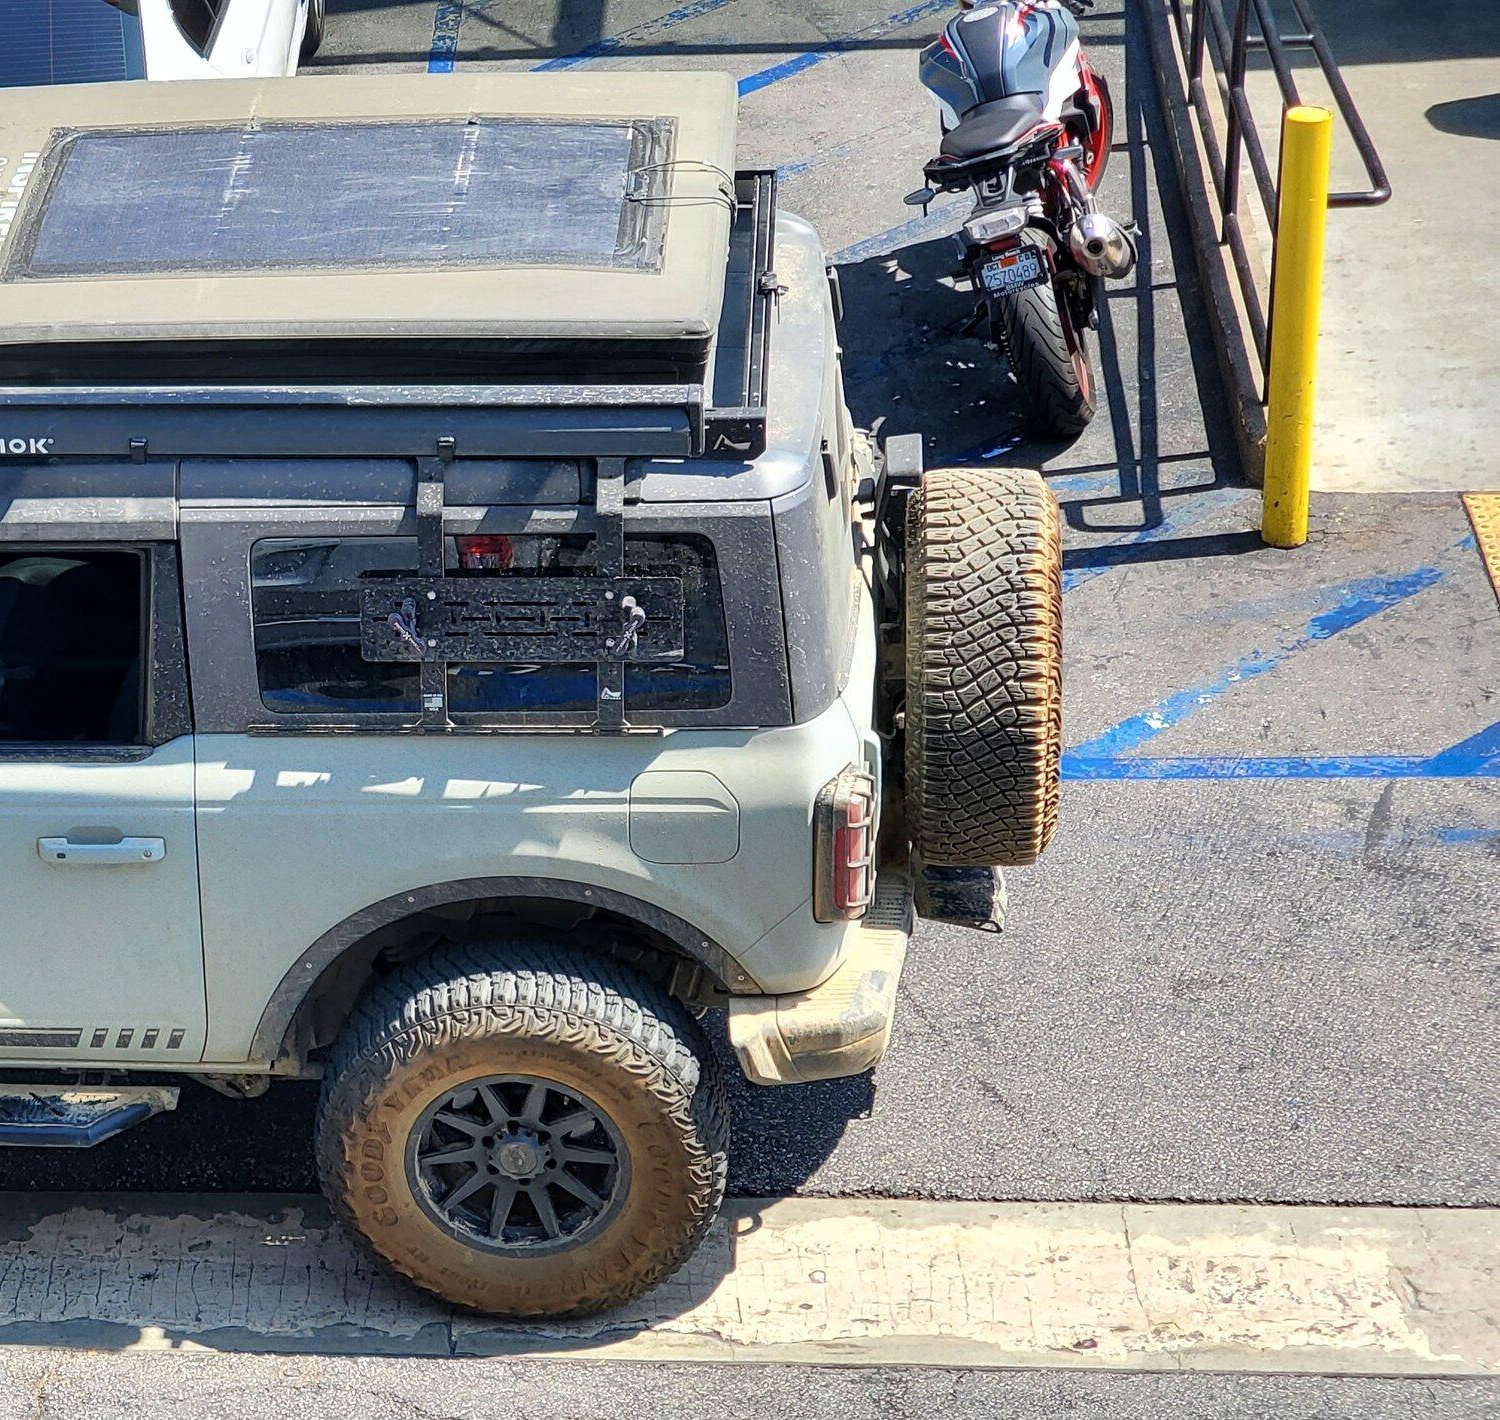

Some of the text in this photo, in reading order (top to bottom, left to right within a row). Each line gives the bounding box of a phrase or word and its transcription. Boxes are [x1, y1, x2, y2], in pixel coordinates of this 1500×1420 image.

[1004, 249, 1021, 258] Beach
[985, 262, 1038, 288] 25Z0489
[993, 282, 1040, 299] Motorcycles
